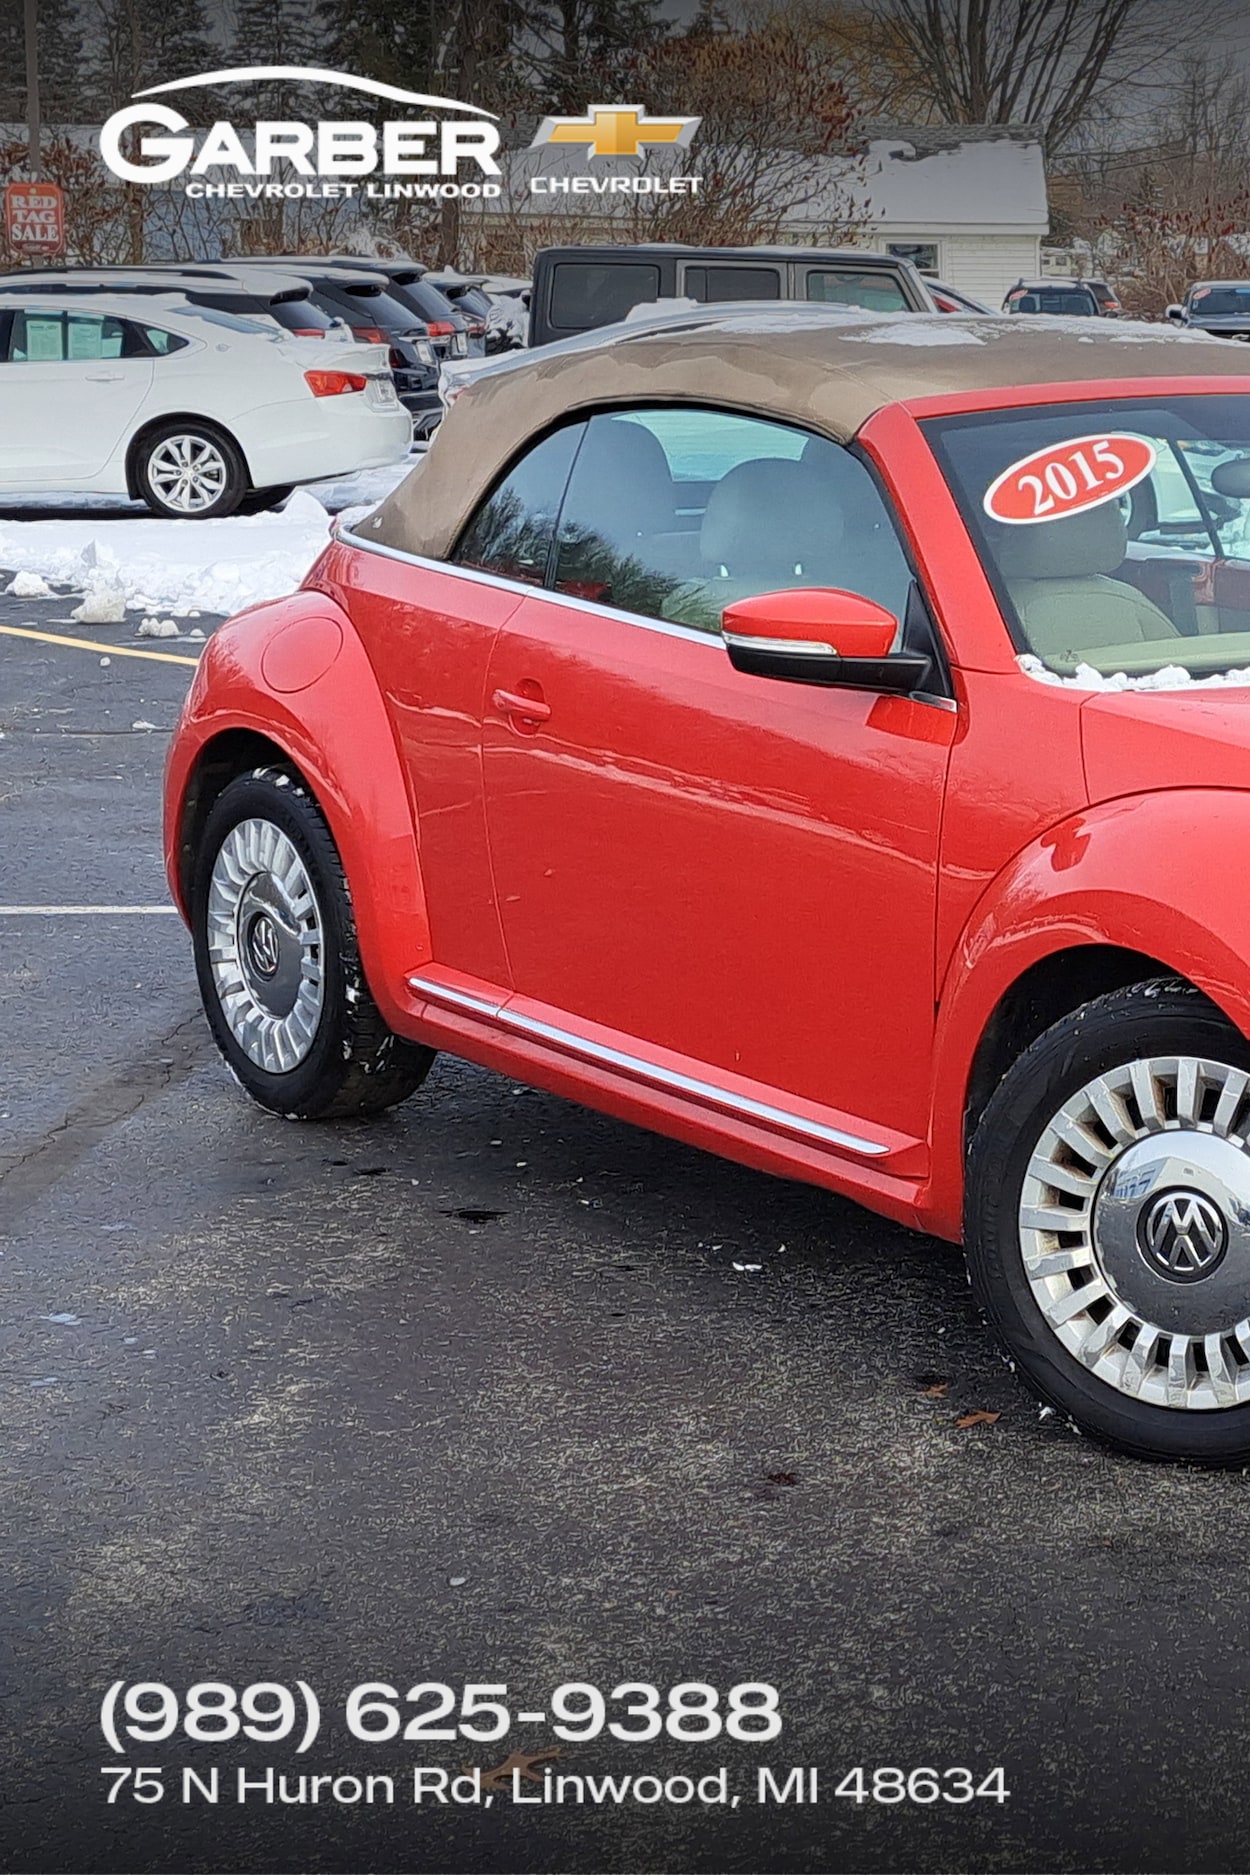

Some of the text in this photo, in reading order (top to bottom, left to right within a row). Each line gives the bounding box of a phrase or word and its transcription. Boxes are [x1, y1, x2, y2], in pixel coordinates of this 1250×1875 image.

[11, 195, 58, 209] RED
[12, 209, 56, 223] TAG
[11, 223, 60, 241] SALE
[1018, 440, 1124, 516] 2015
